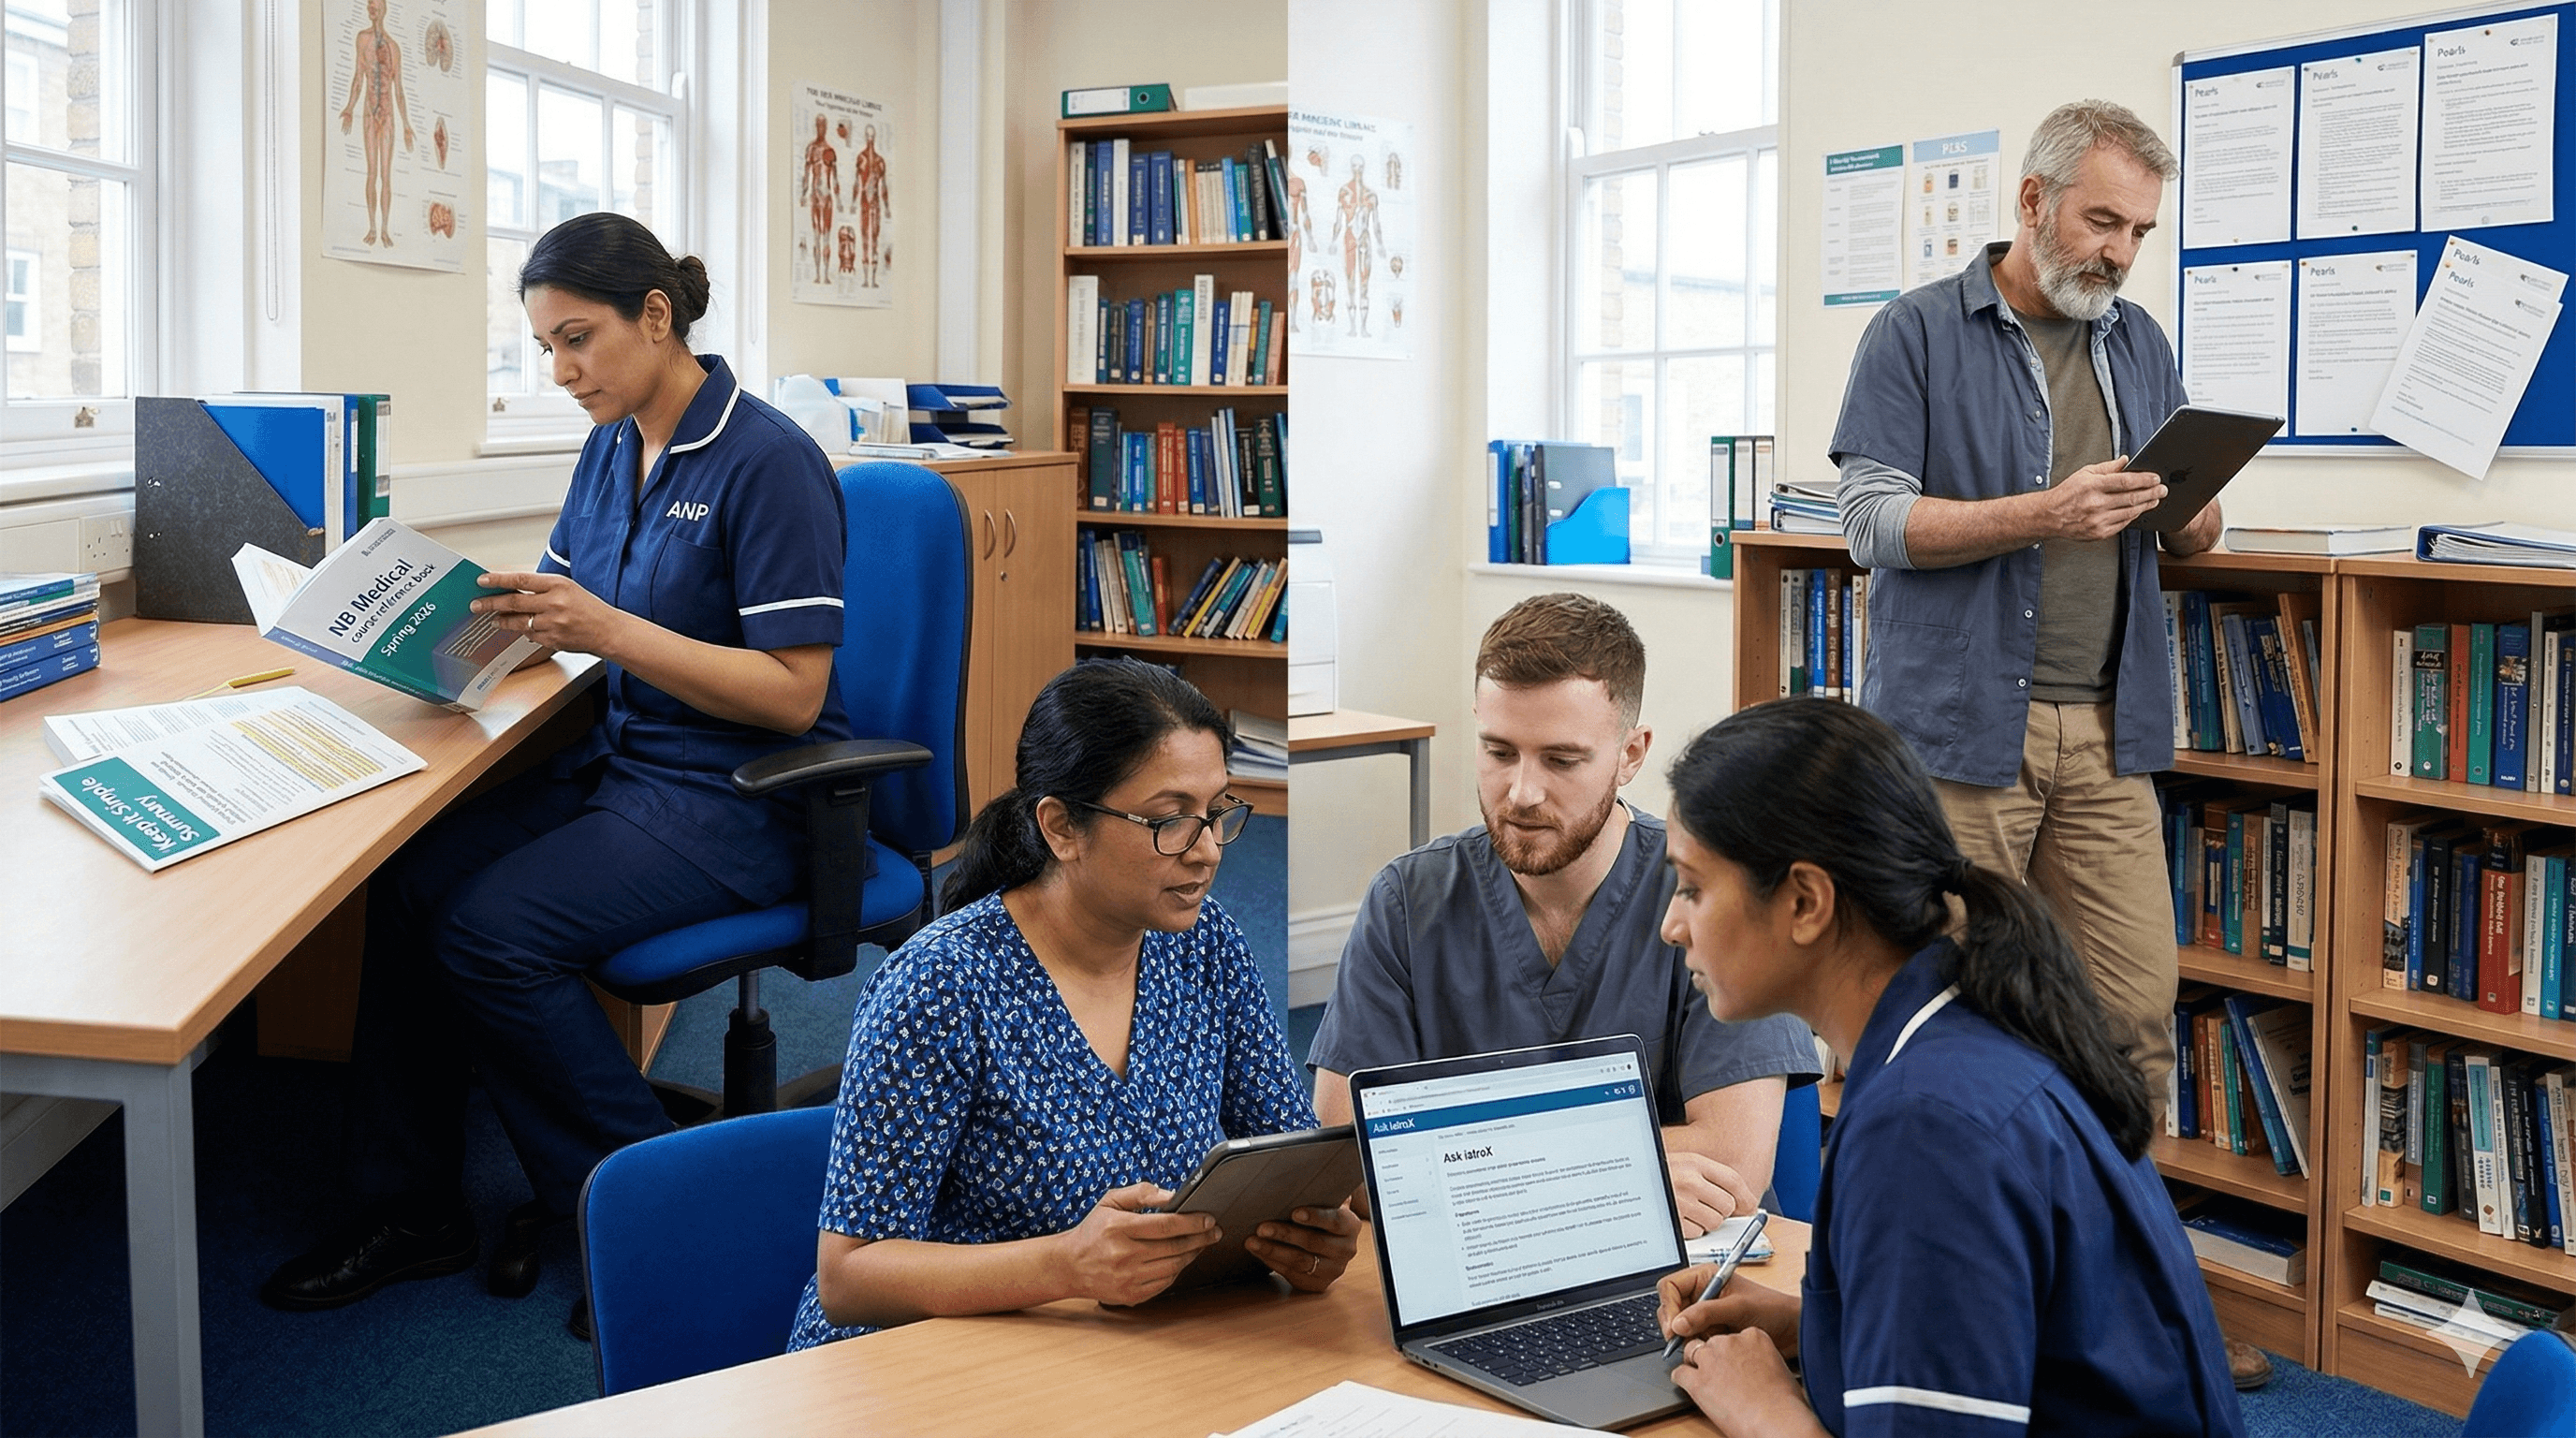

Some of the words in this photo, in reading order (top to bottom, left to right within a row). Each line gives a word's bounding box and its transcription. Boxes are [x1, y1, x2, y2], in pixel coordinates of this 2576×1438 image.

[666, 500, 710, 521] ANP
[328, 611, 357, 638] NB
[350, 558, 414, 612] Medical
[380, 624, 417, 656] Spring
[408, 602, 436, 625] 2026
[81, 776, 132, 815] Simple
[122, 812, 144, 825] It
[136, 821, 177, 852] Keep
[1372, 1123, 1389, 1134] Ask
[1443, 1152, 1463, 1163] Ask
[1464, 1146, 1494, 1160] iatroX
